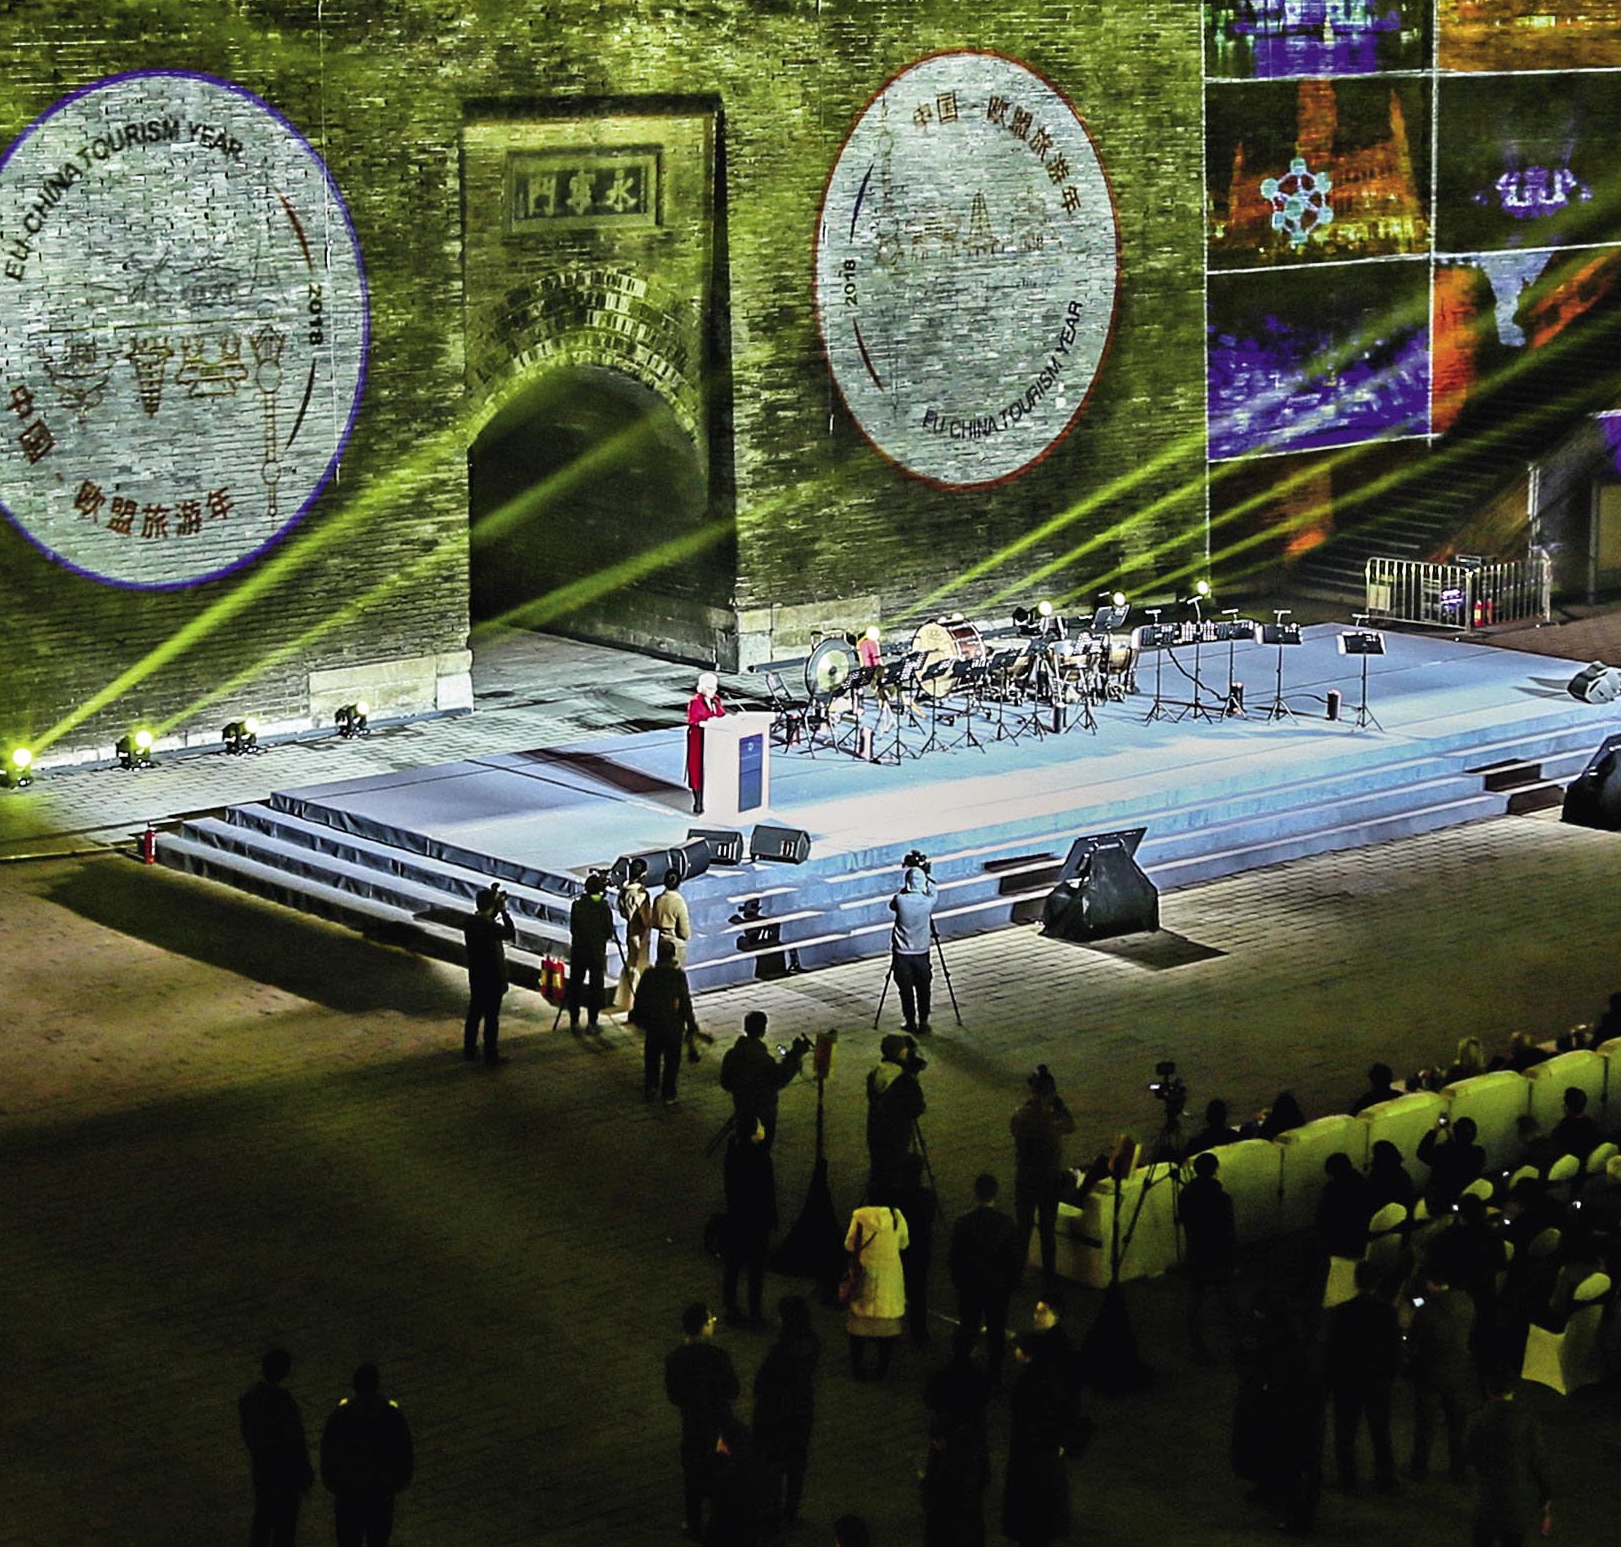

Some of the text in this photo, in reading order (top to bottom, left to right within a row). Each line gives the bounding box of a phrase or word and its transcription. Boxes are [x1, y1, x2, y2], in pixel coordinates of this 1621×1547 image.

[76, 119, 180, 169] TOURISM
[188, 120, 244, 161] YEAR
[844, 259, 858, 308] 2018
[308, 283, 323, 345] 2018
[999, 356, 1063, 429] TOURISM
[1054, 301, 1083, 355] YEAR
